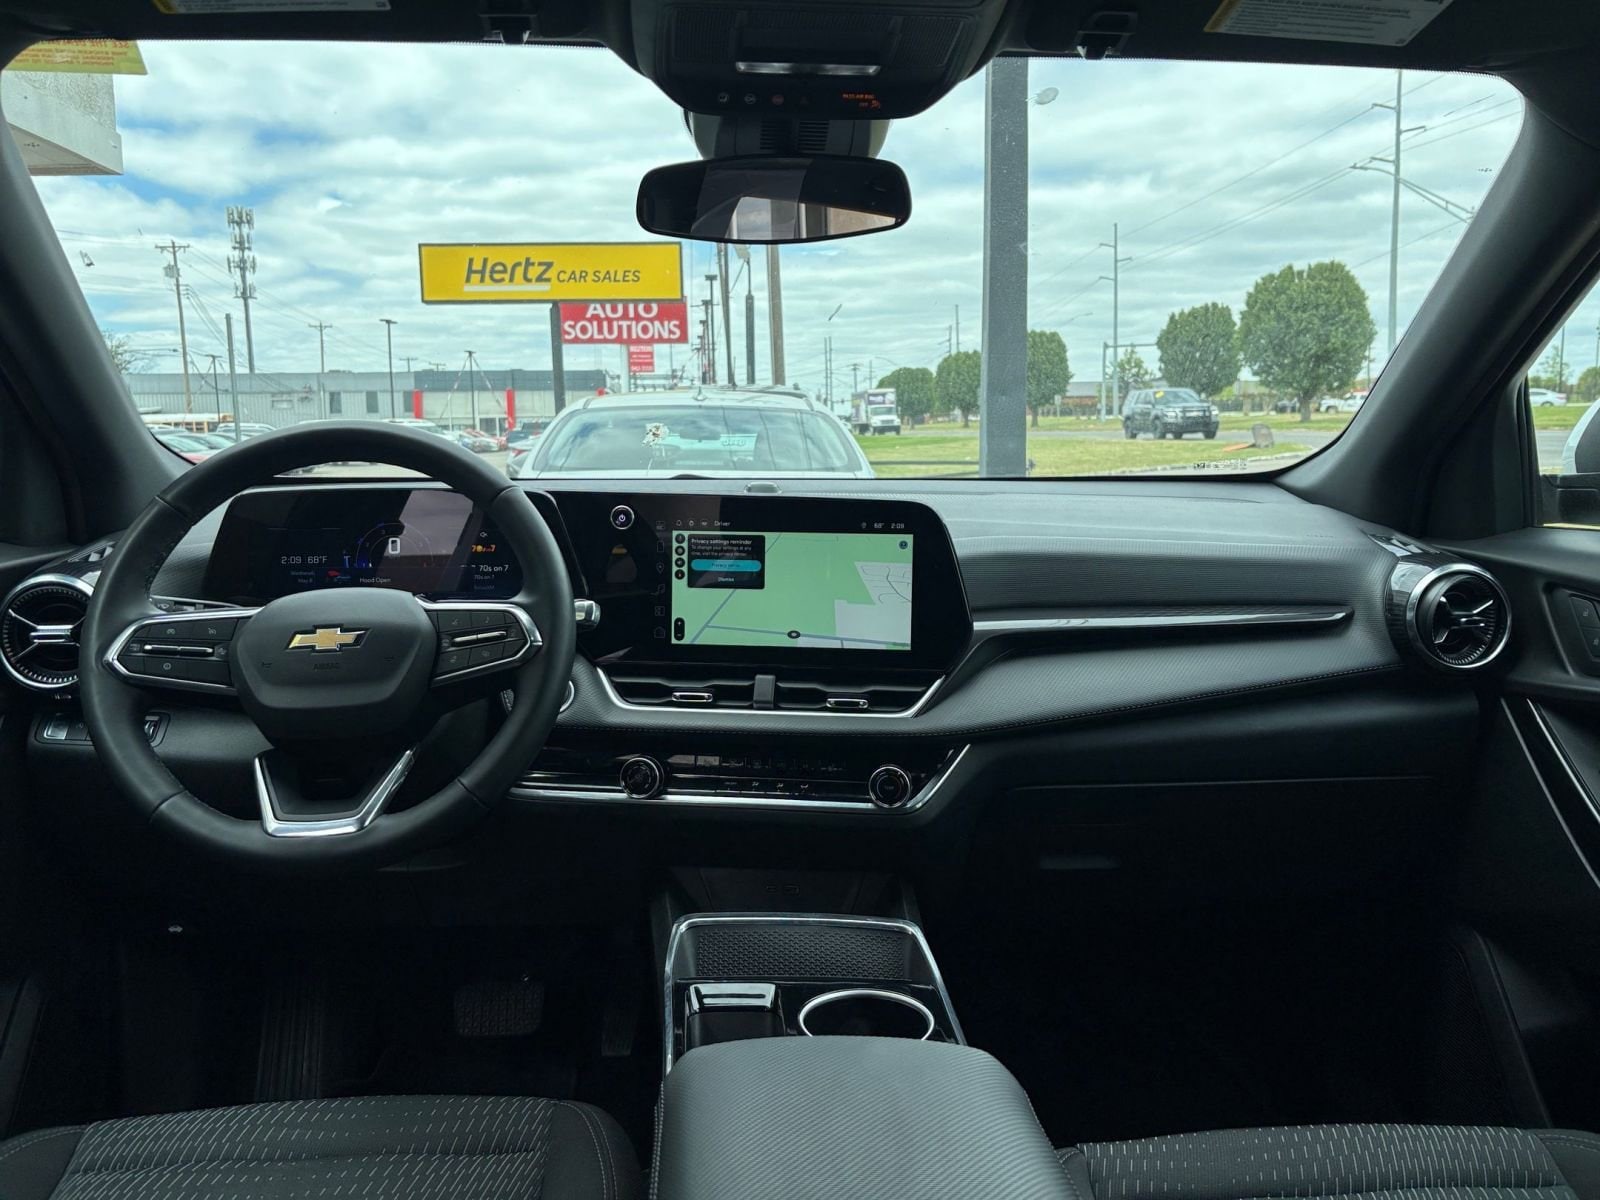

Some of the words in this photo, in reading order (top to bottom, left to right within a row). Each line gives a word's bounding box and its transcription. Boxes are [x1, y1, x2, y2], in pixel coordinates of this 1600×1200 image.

[466, 257, 554, 283] Hertz
[557, 270, 587, 283] CAR
[592, 270, 641, 283] SALES
[563, 320, 681, 340] SOLUTIONS
[281, 555, 302, 564] 2:09
[307, 556, 328, 564] 68°F
